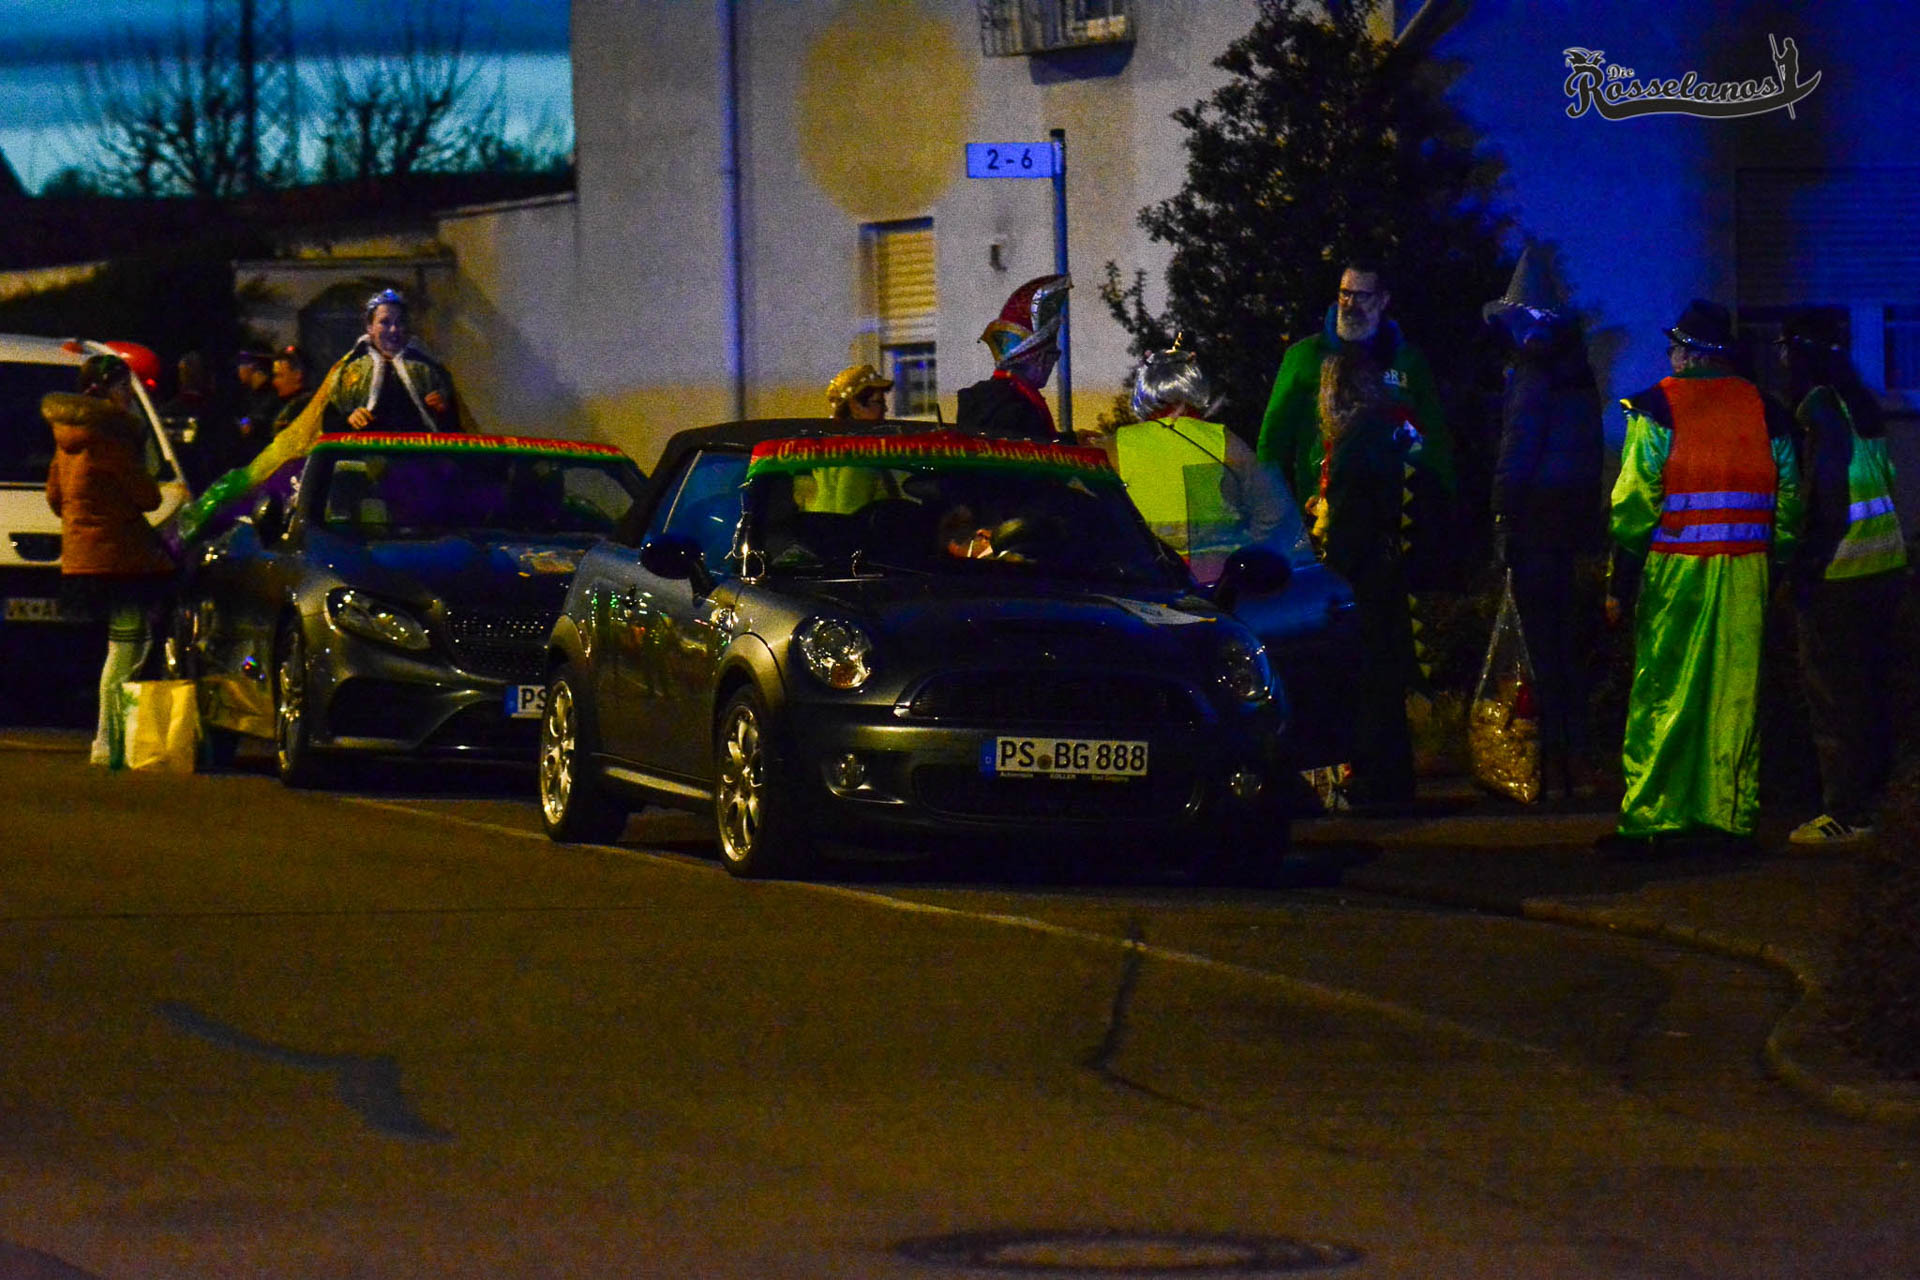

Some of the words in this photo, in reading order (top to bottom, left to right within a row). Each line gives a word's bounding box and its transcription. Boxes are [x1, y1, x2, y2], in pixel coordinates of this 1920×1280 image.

[521, 688, 547, 710] PS
[1000, 740, 1035, 767] PS
[1054, 742, 1089, 769] BG
[1096, 744, 1145, 772] 888
